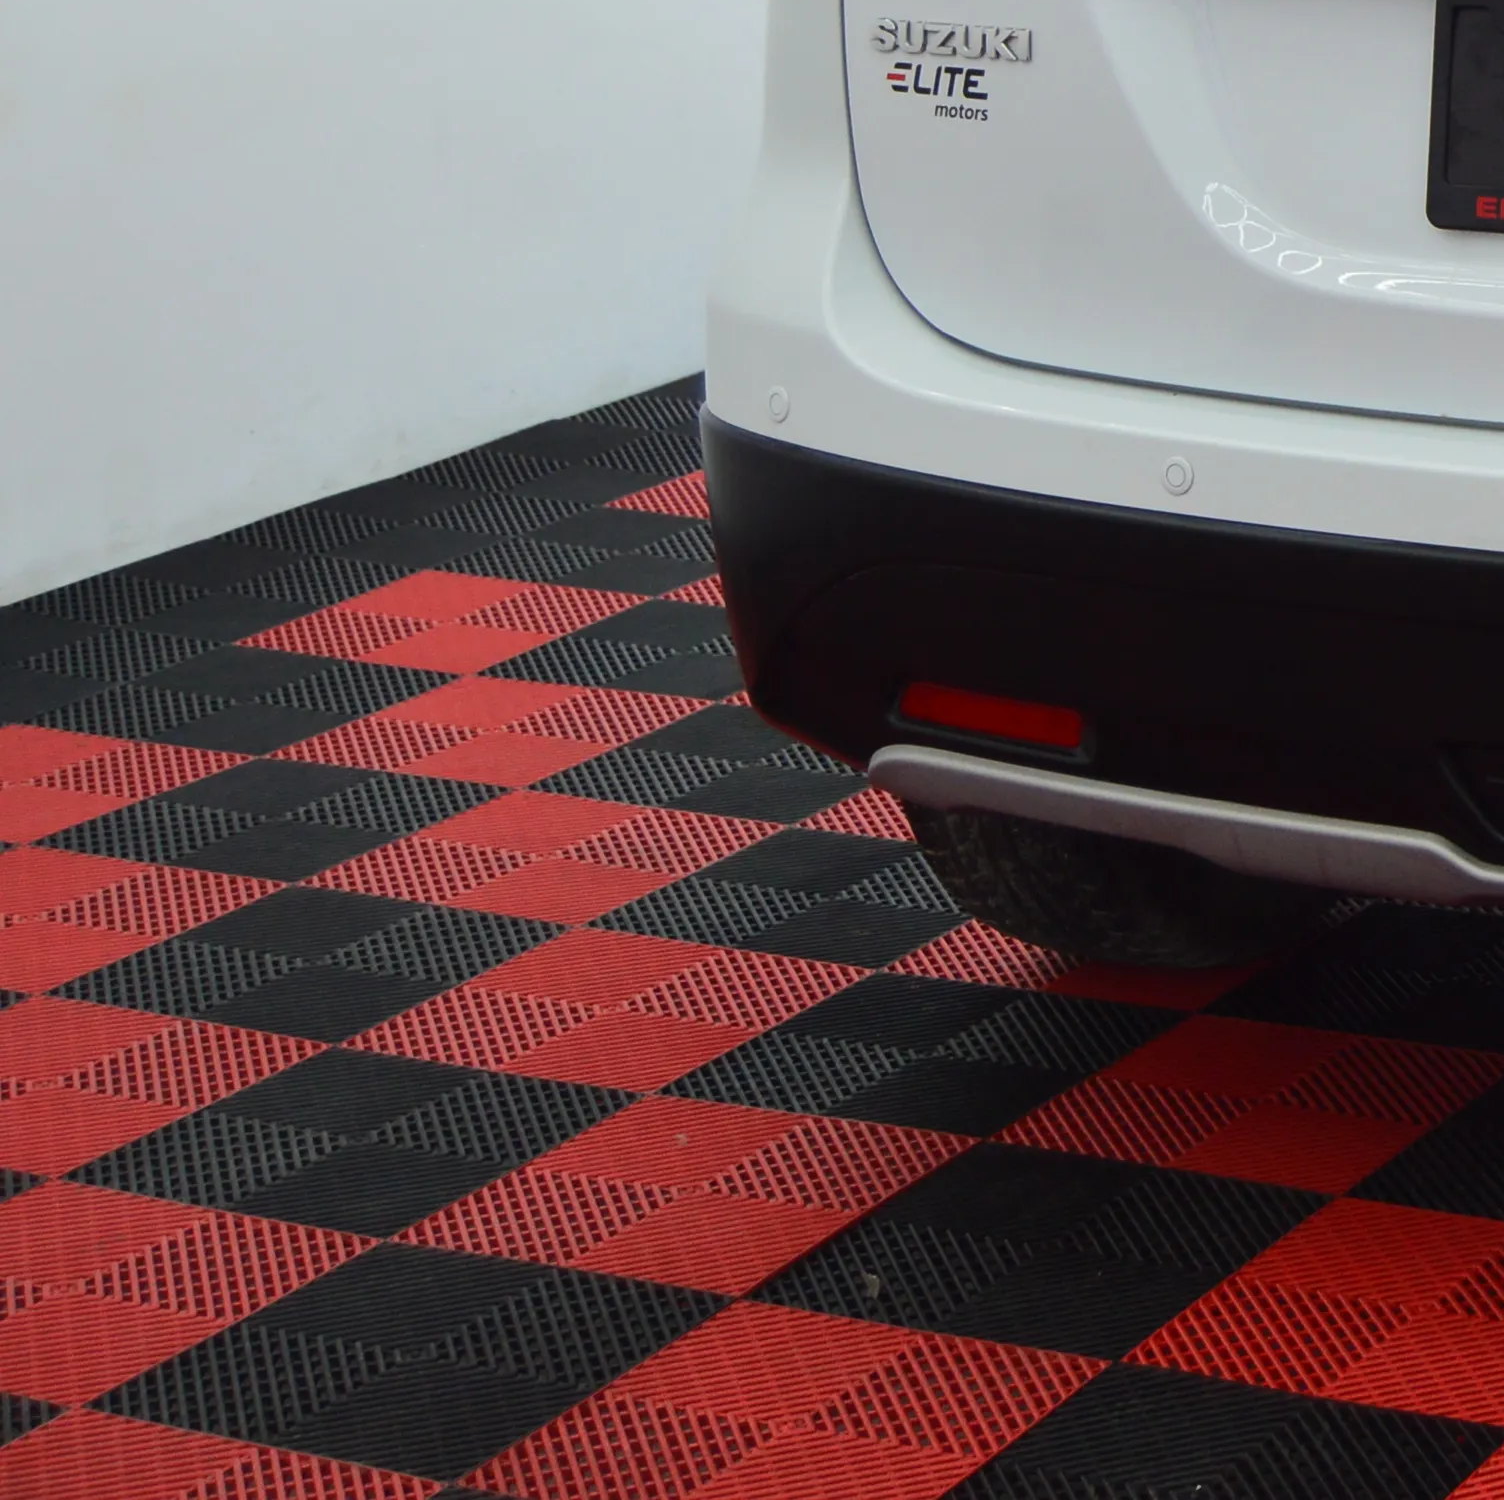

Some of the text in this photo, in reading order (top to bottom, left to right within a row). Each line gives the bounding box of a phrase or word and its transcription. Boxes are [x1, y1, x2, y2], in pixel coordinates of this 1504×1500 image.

[871, 16, 1033, 63] SUZUKI
[886, 61, 989, 100] ELITE
[934, 104, 989, 122] motors
